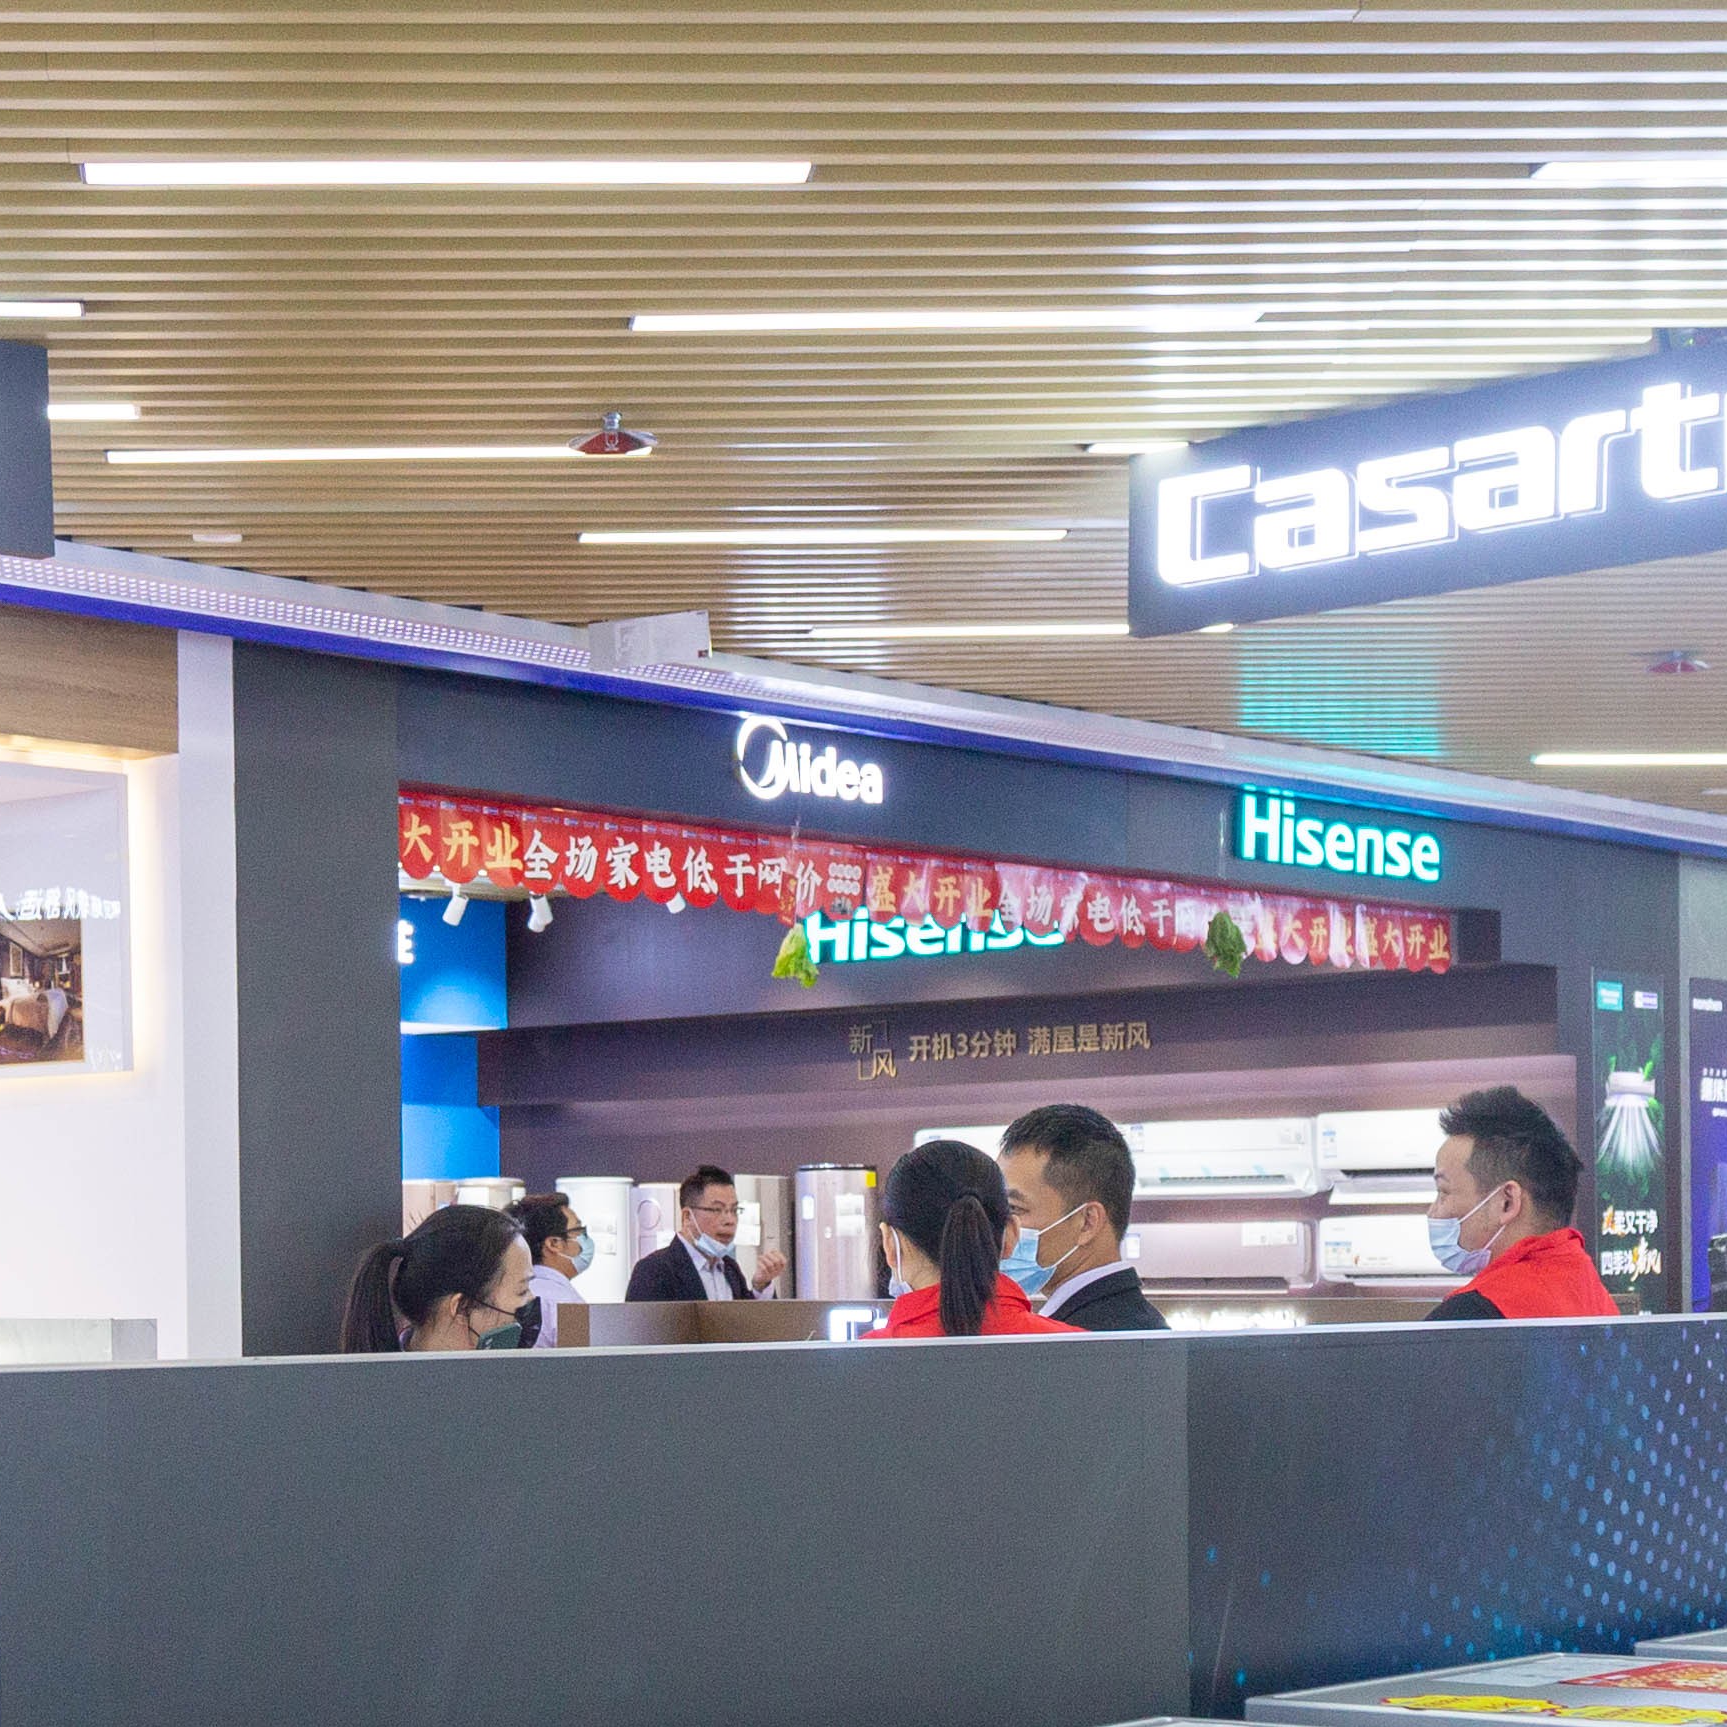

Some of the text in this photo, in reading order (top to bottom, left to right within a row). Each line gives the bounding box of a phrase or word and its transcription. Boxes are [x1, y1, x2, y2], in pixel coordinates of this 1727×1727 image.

[737, 715, 884, 804] Midea
[1239, 790, 1442, 882] Hisense
[909, 1021, 1151, 1062] 开机3分钟 满屋是新风
